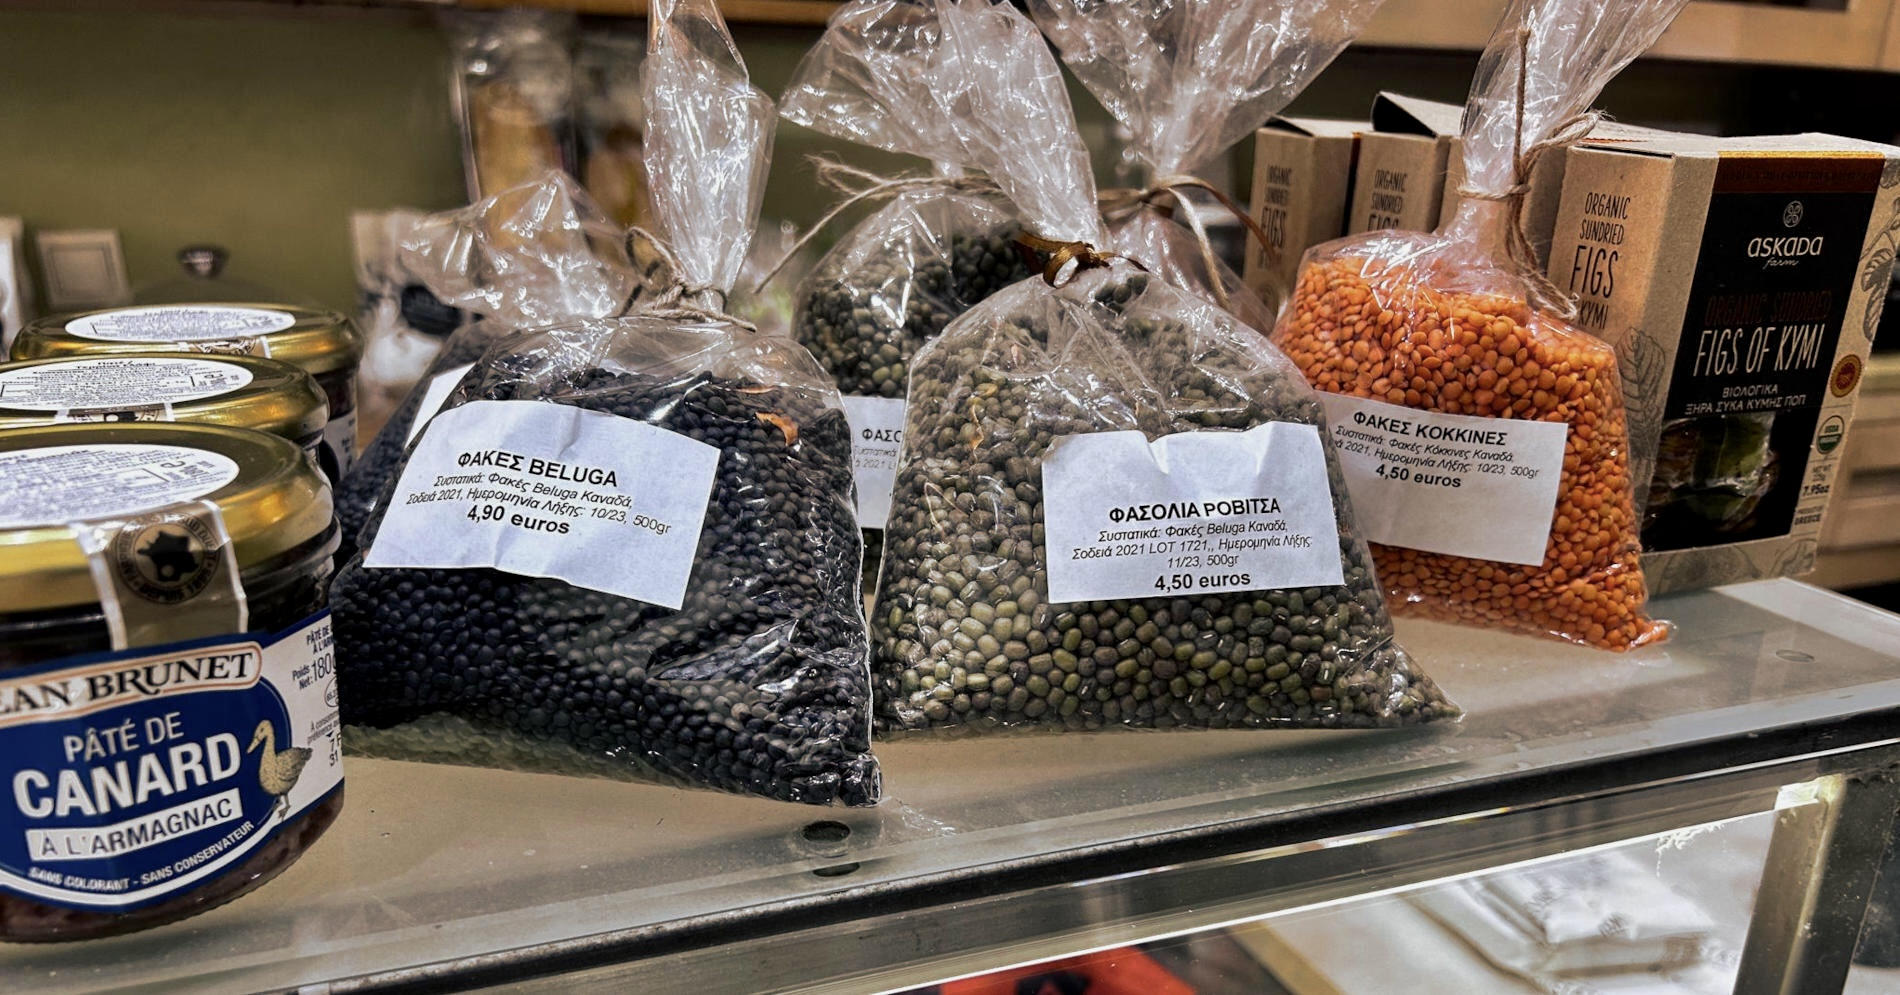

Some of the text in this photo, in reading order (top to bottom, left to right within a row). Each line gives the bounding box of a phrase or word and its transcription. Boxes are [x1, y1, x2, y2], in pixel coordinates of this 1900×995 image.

[1374, 169, 1408, 192] ORGANIC
[1585, 192, 1630, 220] ORGANIC
[1580, 219, 1624, 245] SUNDRIED
[1569, 245, 1619, 298] FIGS
[1762, 256, 1799, 270] farm
[1578, 300, 1609, 330] KYMI
[1693, 323, 1825, 376] FIGS OF KYMI
[1684, 394, 1806, 415] ΞΗΡΑ ΣΥΚΑ ΚΥΜΗΣ ΠΟΠ
[1722, 384, 1778, 398] ΒΙΟΛΟΓΙΚΑ
[1336, 425, 1385, 445] Συστατικά:
[1389, 438, 1422, 455] Φακές
[1424, 444, 1471, 460] Κόκκινες
[1353, 411, 1508, 446] ΦΑΚΕΣ ΚΟΚΚΙΝΕΣ
[458, 451, 617, 487] ΦΑΚΕΣ BELUGA
[1374, 448, 1436, 467] Ημερομηνία
[1510, 465, 1540, 480] 500gr
[1375, 464, 1461, 488] 4,50 euros
[434, 472, 632, 509] Συστατικά: Φακές Beluga Καναδά,
[406, 488, 671, 535] Σοδειά 2021, Ημερομηνία Λήξης: 10/23, 500gr
[467, 504, 570, 534] 4,90 euros
[1109, 498, 1281, 523] ΦΑΣΟΛΙΑ ΡΟΒΙΤΣΑ
[1098, 519, 1288, 542] Συστατικά: Φακές Beluga Καναδά,
[1072, 546, 1113, 560] Σοδειά
[1116, 543, 1145, 556] 2021
[1149, 541, 1176, 554] LOT
[1218, 535, 1280, 551] Ημερομηνία
[1168, 554, 1239, 569] 11/23, 500gr
[1154, 573, 1251, 593] 4,50 euros
[86, 652, 253, 701] BRUNET
[292, 665, 310, 681] Poids
[299, 676, 313, 690] Net:
[63, 712, 184, 763] PÂTÉ DE
[13, 732, 241, 819] CANARD
[66, 798, 233, 856] L'ARMAGNAC
[28, 866, 63, 885] SANS
[64, 875, 130, 892] COLORANT
[141, 866, 173, 885] SANS
[174, 821, 255, 873] CONSERVATEUR
